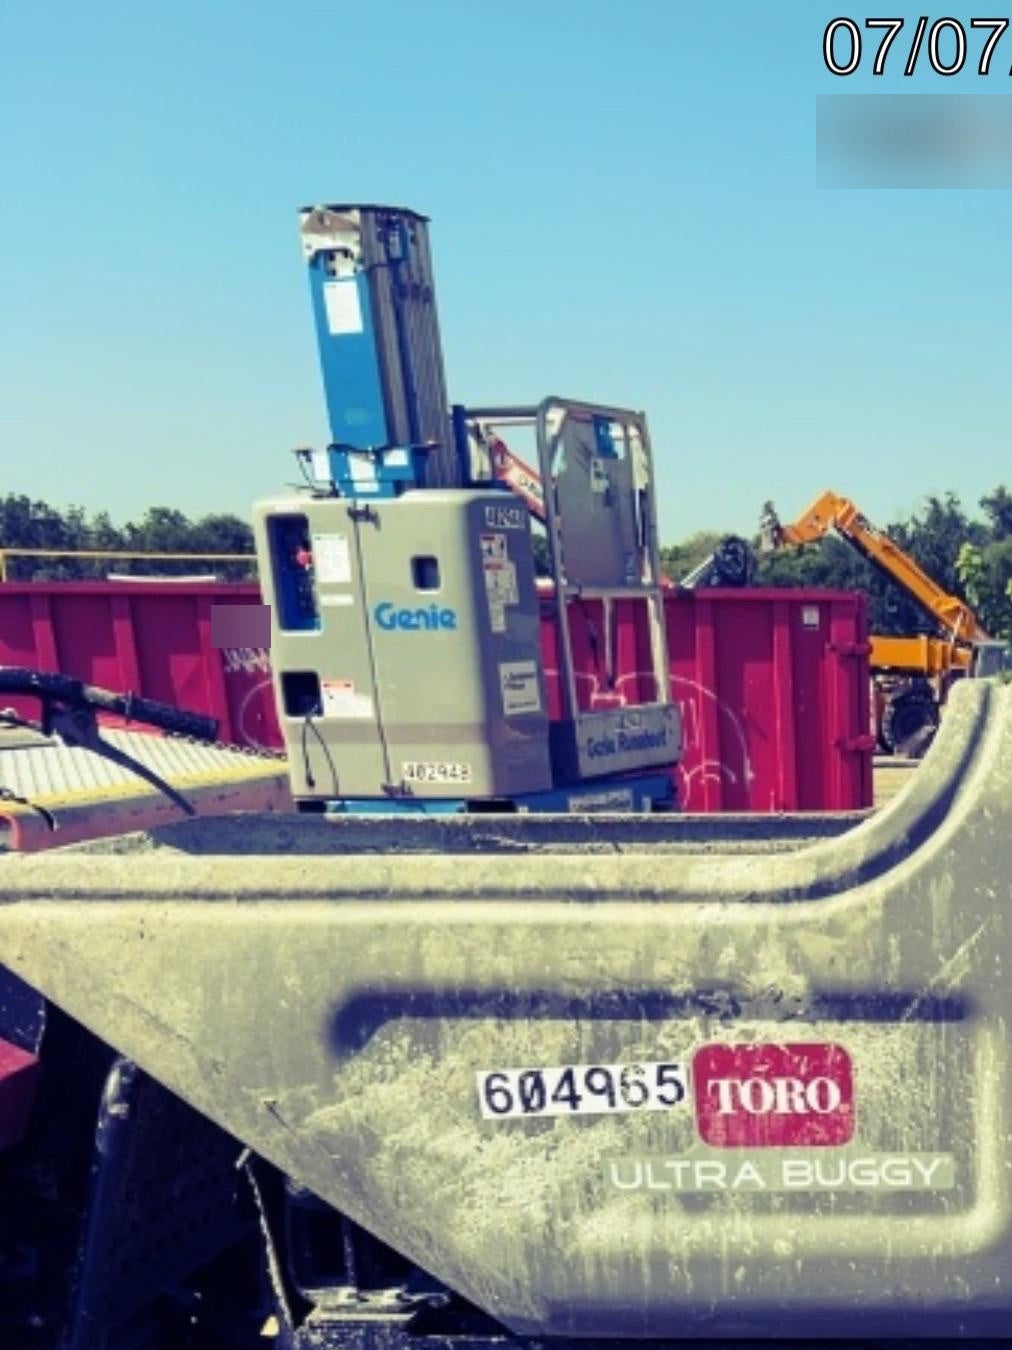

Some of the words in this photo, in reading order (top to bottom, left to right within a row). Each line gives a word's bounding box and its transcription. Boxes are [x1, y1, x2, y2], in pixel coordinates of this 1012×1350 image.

[375, 602, 457, 631] Genie
[484, 1063, 686, 1115] 604965
[707, 1079, 841, 1114] TORO
[610, 1161, 764, 1190] ULTRA
[783, 1157, 939, 1187] BUGGY
